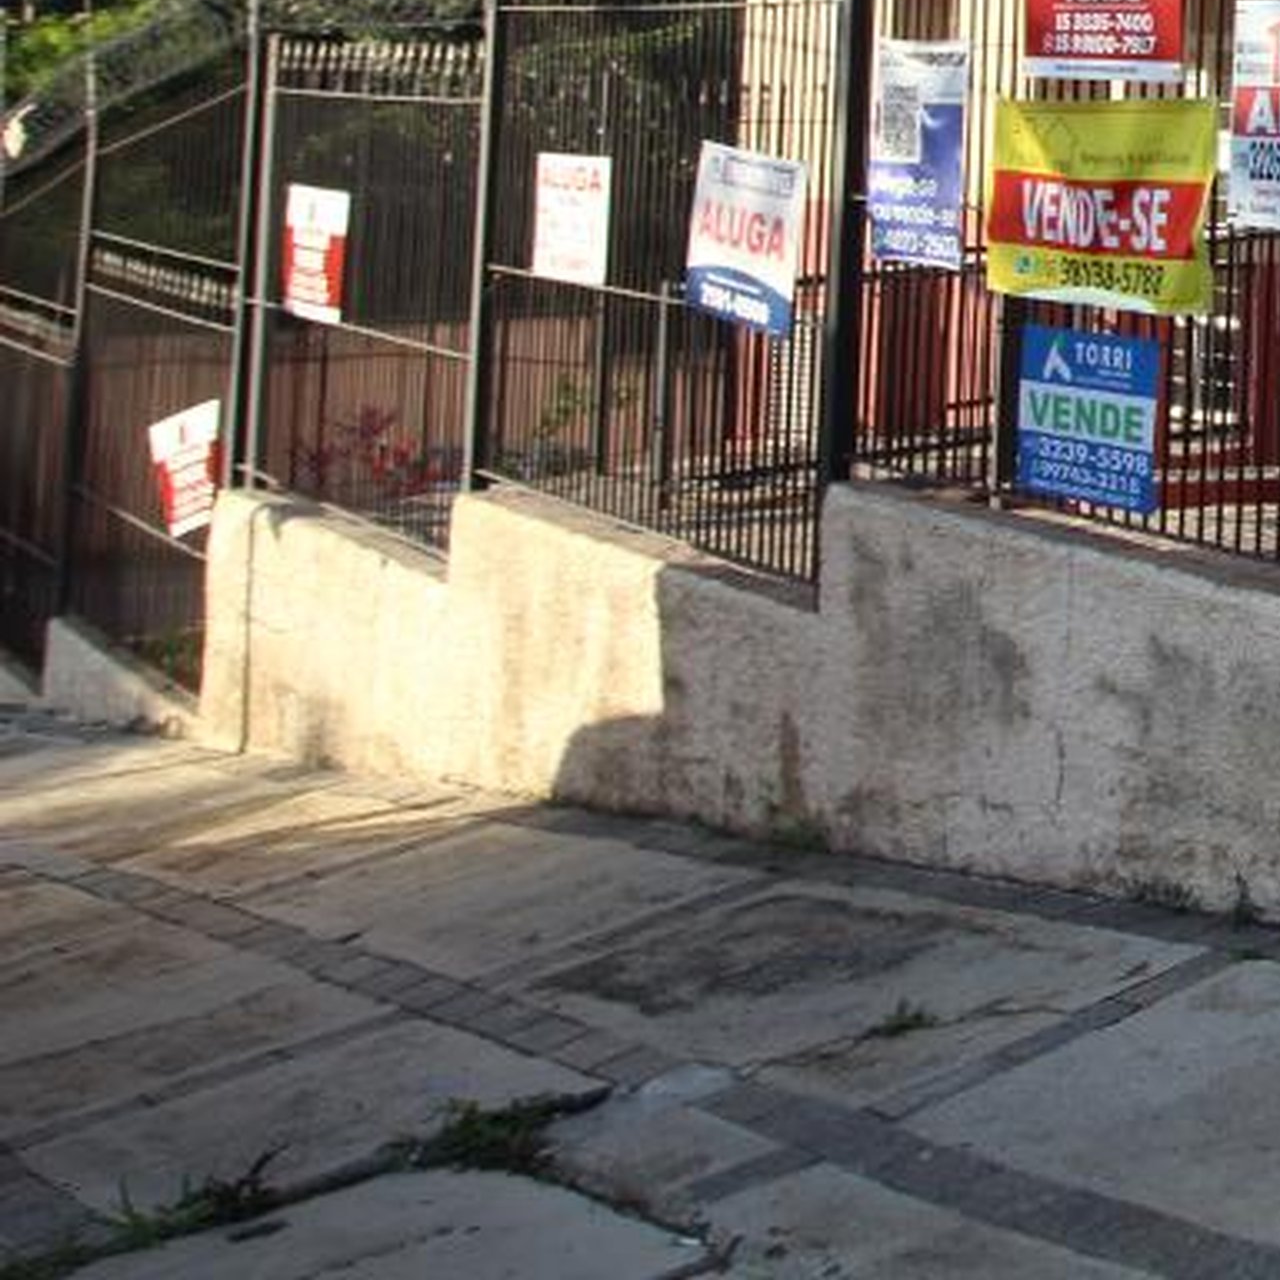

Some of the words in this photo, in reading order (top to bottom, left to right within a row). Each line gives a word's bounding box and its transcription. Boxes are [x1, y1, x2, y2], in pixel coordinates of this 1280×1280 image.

[698, 194, 786, 263] ALUGA
[1021, 179, 1172, 252] VENDE-SE
[1074, 341, 1133, 370] TORRI
[1029, 389, 1145, 444] VENDE
